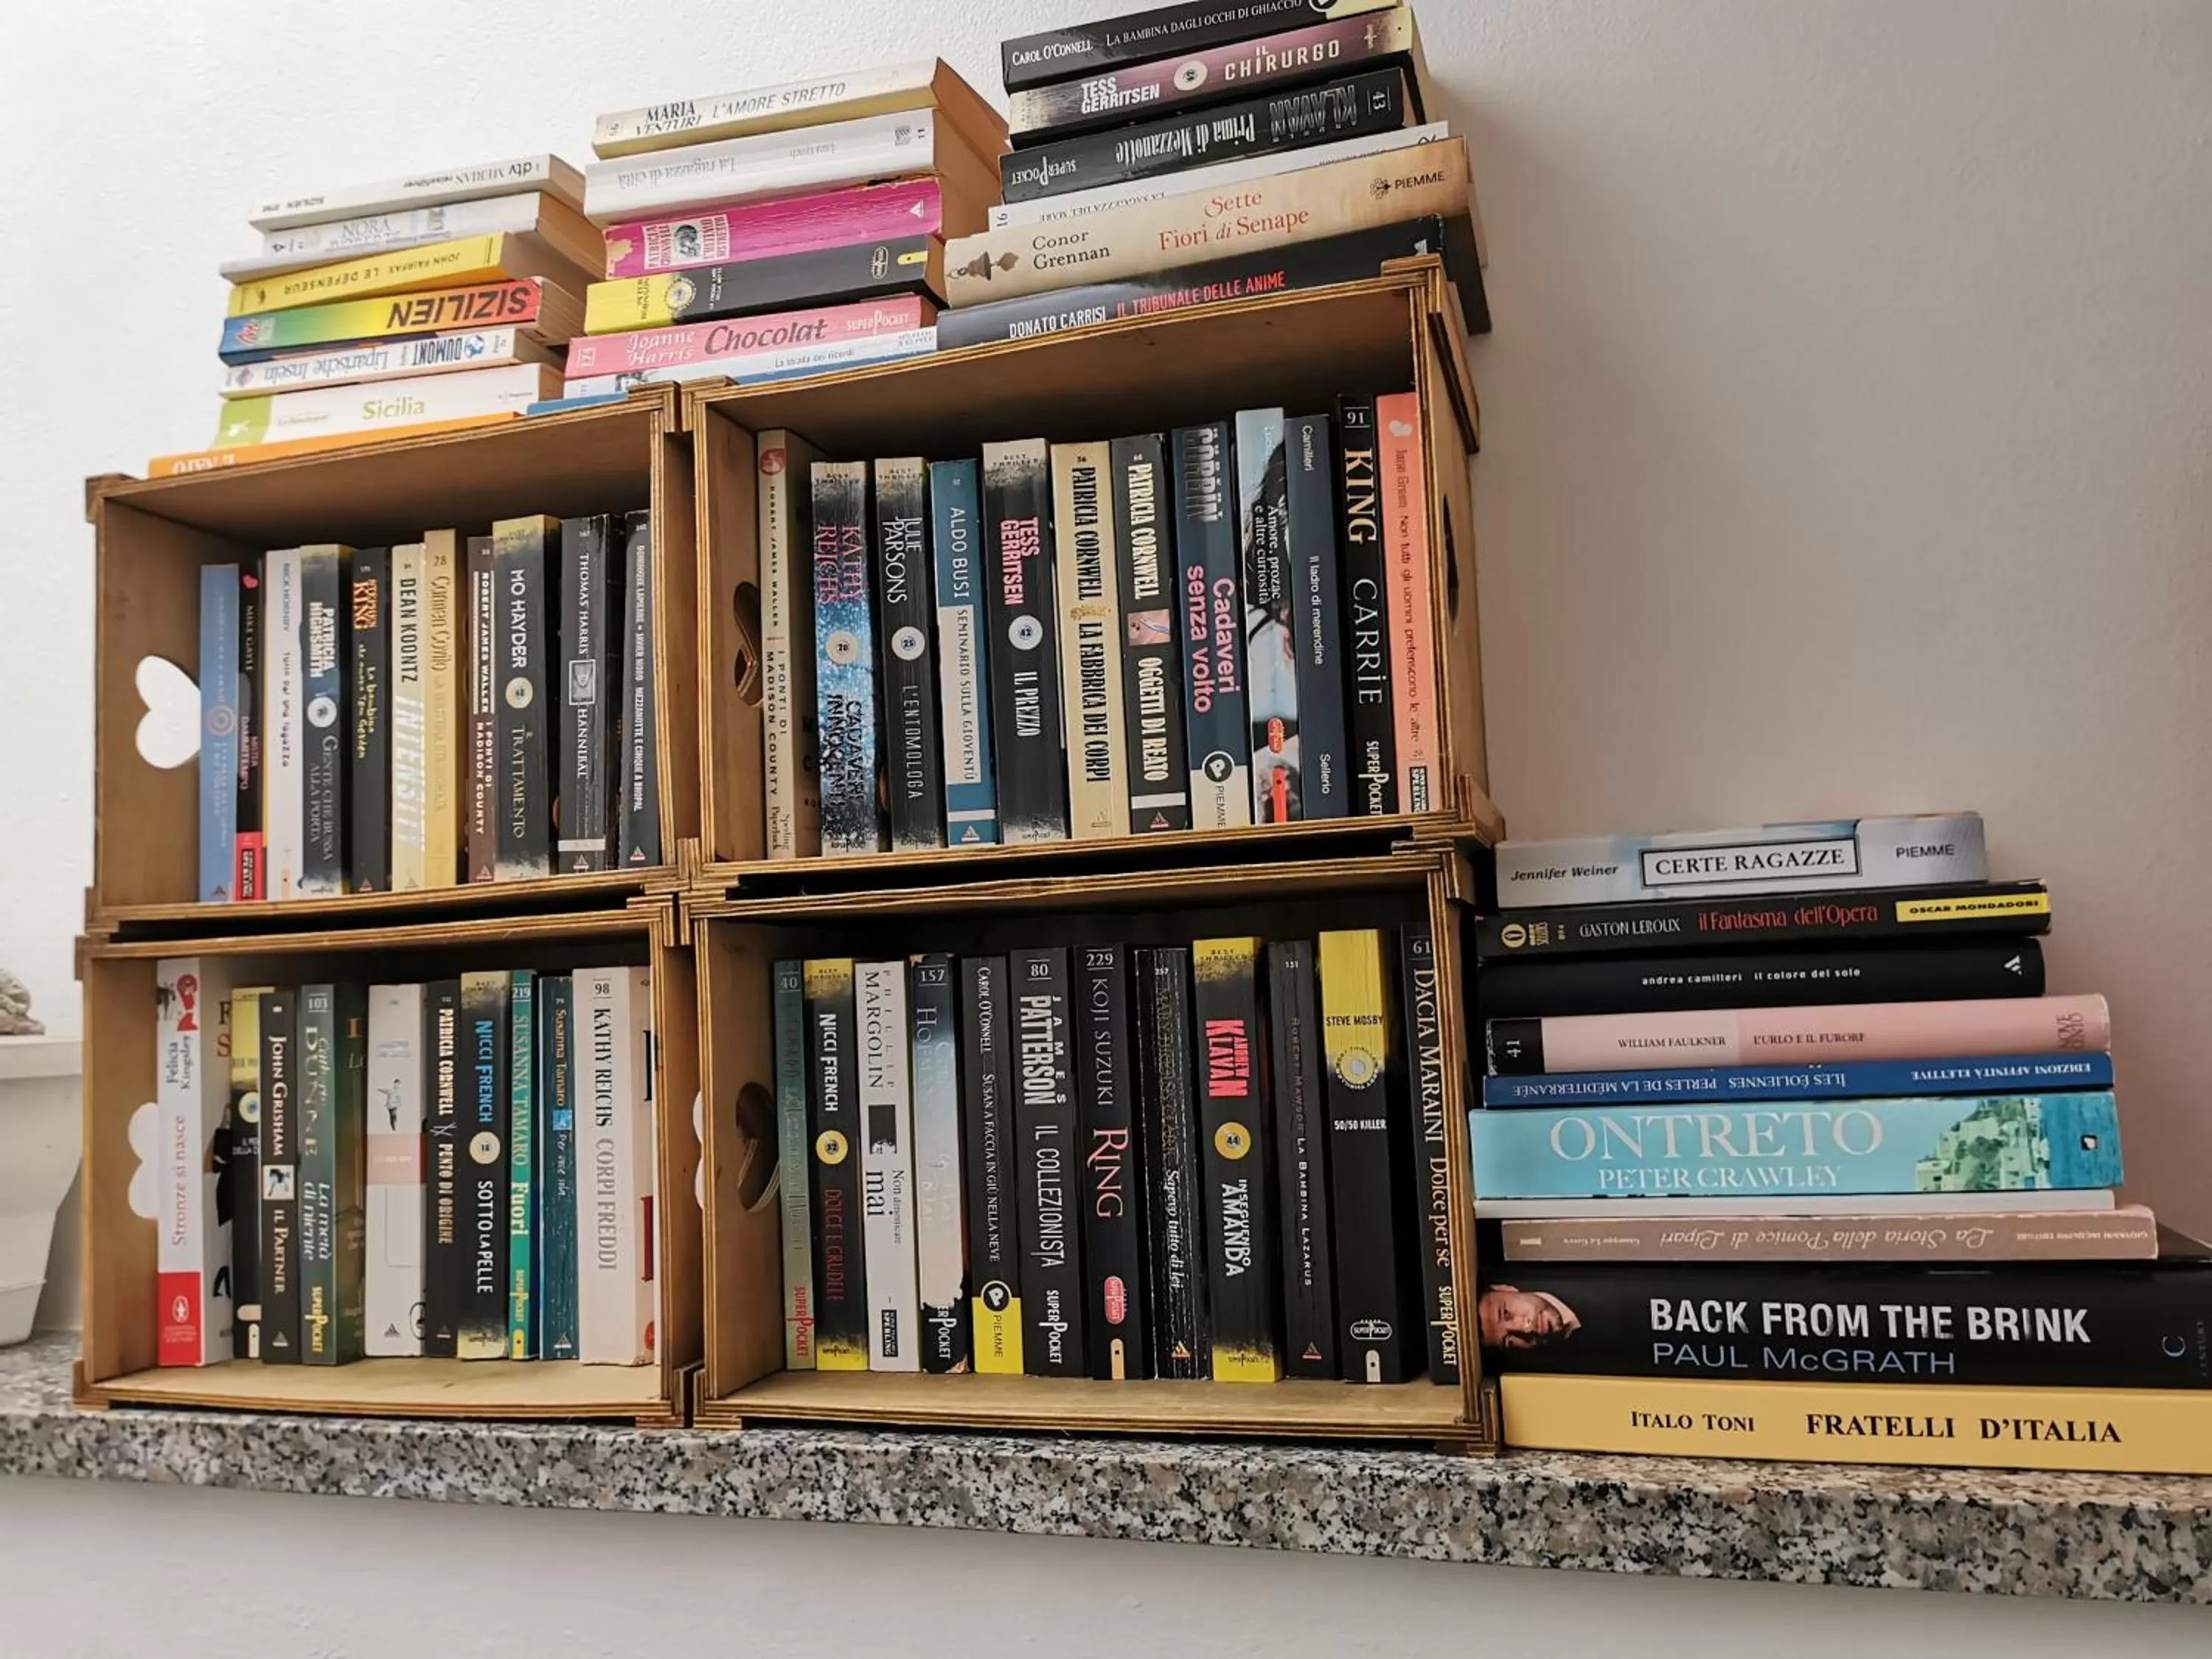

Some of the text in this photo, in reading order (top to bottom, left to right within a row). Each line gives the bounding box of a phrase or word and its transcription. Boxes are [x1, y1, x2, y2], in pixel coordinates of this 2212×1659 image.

[1123, 24, 1168, 45] BAMBINA
[646, 100, 696, 121] MARIA
[781, 82, 846, 106] STRETTO
[1081, 79, 1117, 100] TESS
[1081, 85, 1160, 114] GERRITSEN
[1116, 114, 1256, 165] Prima Mezzanotte
[456, 161, 533, 183] dtv MERIAN
[664, 160, 715, 181] ragazza
[1394, 170, 1445, 190] PIEMME
[1204, 189, 1262, 218] Sette
[1032, 230, 1088, 253] Conor
[1159, 209, 1310, 251] Fiori Senape
[389, 258, 431, 274] FAIRFAX
[1032, 245, 1110, 271] Grennan
[387, 286, 530, 329] SIZILIEN
[1009, 271, 1285, 339] DONATO CARRISI TRIBUNALE DELLE ANIME
[412, 336, 462, 366] DUMONT
[627, 331, 695, 353] Joanne
[627, 344, 693, 366] Harris
[705, 318, 829, 355] Chocolat
[313, 350, 389, 377] Liparische
[362, 398, 426, 420] Sicilia
[1345, 448, 1377, 544] KING
[1397, 478, 1409, 508] Green
[950, 507, 969, 599] ALDO BUSI
[1020, 518, 1039, 556] TESS
[1072, 466, 1102, 601] PATRICIA CORNWELL
[1129, 464, 1159, 599] PATRICIA CORNWELL
[1303, 425, 1324, 664] Camilleri merendine
[815, 524, 841, 605] REICHS
[842, 525, 863, 602] KATHY
[883, 521, 907, 604] PARSONS
[1001, 520, 1024, 605] GERRITSEN
[354, 582, 371, 630] KING
[510, 569, 526, 668] MO HAYDER
[579, 554, 590, 654] THOMAS HARRIS
[308, 602, 324, 677] HIGHSMITH
[323, 608, 335, 670] PATRICIA
[400, 578, 419, 684] DEAN KOONTZ
[481, 572, 490, 713] ROBERT JAMES WALLER
[1186, 566, 1215, 712] senza volto
[1213, 578, 1238, 693] Cadaveri
[955, 610, 973, 716] SEMINARIO SULLA
[766, 650, 779, 795] MADISON COUNTY
[1016, 687, 1040, 736] PREZZO
[1082, 643, 1110, 782] FABBRICA CORPI
[1138, 657, 1169, 780] OGGETTI REATO
[577, 709, 588, 779] HANNIBAL
[633, 686, 644, 811] MEZZANOTTE BHOPAL
[476, 722, 484, 834] MADISON COUNTY
[1320, 754, 1332, 793] Sellerio
[770, 805, 782, 849] Paperback
[1511, 865, 1618, 882] Jennifer Weiner
[1655, 849, 1845, 875] CERTE RAGAZZE
[1896, 844, 1955, 858] PIEMME
[1711, 905, 1787, 931] Fantasma
[1909, 900, 2039, 914] OSCAR MONDADORI
[1086, 953, 1113, 966] 229
[1642, 967, 1860, 986] andrea camilleri colore del sole
[439, 1009, 454, 1056] PATRICIA
[865, 972, 883, 1088] MARGOLIN
[1090, 978, 1113, 1106] KOJI SUZUKI
[1323, 1015, 1383, 1026] STEVE MOSBY
[1618, 1034, 1793, 1048] WILLIAM FAULKNER L'URLO
[475, 1020, 494, 1122] NICCI FRENCH
[512, 1015, 529, 1091] SUSANNA
[555, 1009, 567, 1106] Susanna Tamaro
[594, 1008, 613, 1127] KATHY REICHS
[819, 1013, 838, 1111] NICCI FRENCH
[1020, 995, 1057, 1105] PATTERSON
[1911, 1063, 2090, 1080] EDIZIONI AFFINITÀ ELETTIVE
[270, 1036, 288, 1155] JOHN GRISHAM
[1512, 1077, 1717, 1096] PERLES MÉDITERRANÉE
[984, 1121, 996, 1158] FACCIA
[1358, 1119, 1385, 1130] KILLER
[1551, 1109, 1883, 1161] ONTRETO
[866, 1171, 892, 1217] mai
[893, 1169, 905, 1194] Non
[1088, 1126, 1128, 1217] RING
[1165, 1168, 1181, 1216] Sapevo
[1428, 1156, 1448, 1209] Dolce
[1599, 1165, 1841, 1190] PETER CRAWLEY
[511, 1181, 530, 1235] Fuori
[987, 1197, 998, 1231] NELLA
[1030, 1148, 1065, 1267] COLLEZIONISTA
[1222, 1183, 1245, 1276] AMANDA
[1239, 1178, 1252, 1267] INSEGUENDO
[303, 1205, 317, 1261] niente
[476, 1180, 493, 1293] SOTTO PELLE
[988, 1234, 1000, 1262] NEVE
[1661, 1229, 1947, 1250] Storia Lipari
[992, 1315, 1003, 1357] PIEMME
[1649, 1298, 2091, 1343] BACK FROM THE BRINK
[1652, 1343, 1955, 1374] PAUL McGRATH
[1631, 1411, 2122, 1443] ITALO TONI FRATELLI D'ITALIA
